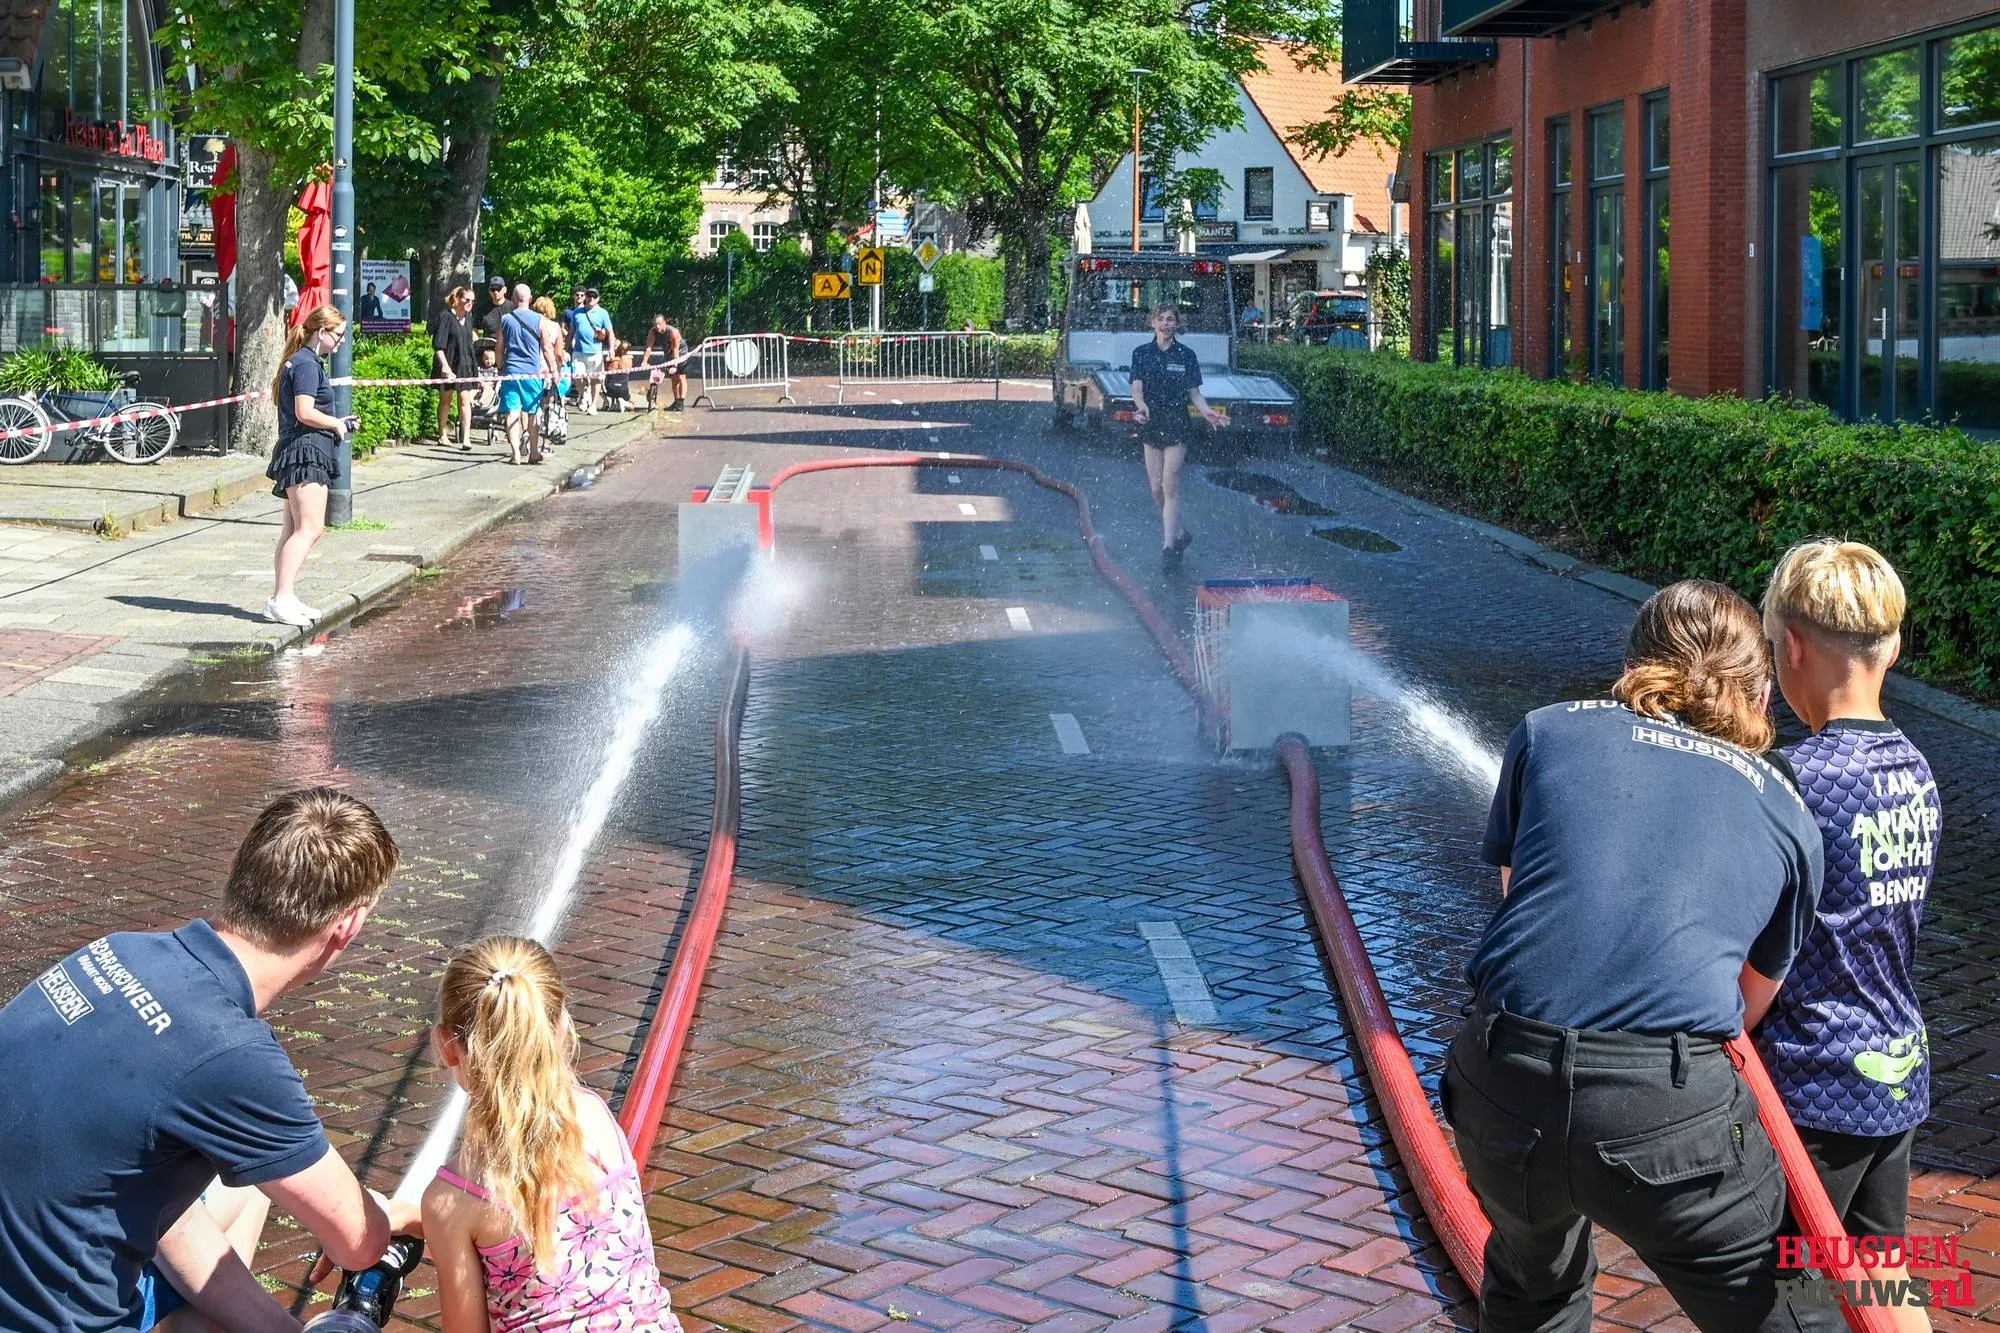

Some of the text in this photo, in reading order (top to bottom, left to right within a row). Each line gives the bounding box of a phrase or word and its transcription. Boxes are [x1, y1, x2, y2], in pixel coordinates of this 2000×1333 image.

[190, 161, 217, 173] Rest
[865, 262, 877, 276] N
[820, 278, 833, 292] A
[1636, 727, 1763, 790] HEUSDEN
[1873, 769, 1920, 797] I AM
[1906, 841, 1933, 868] THE
[1868, 875, 1927, 907] BENCH
[40, 965, 90, 1020] HEUSDEN
